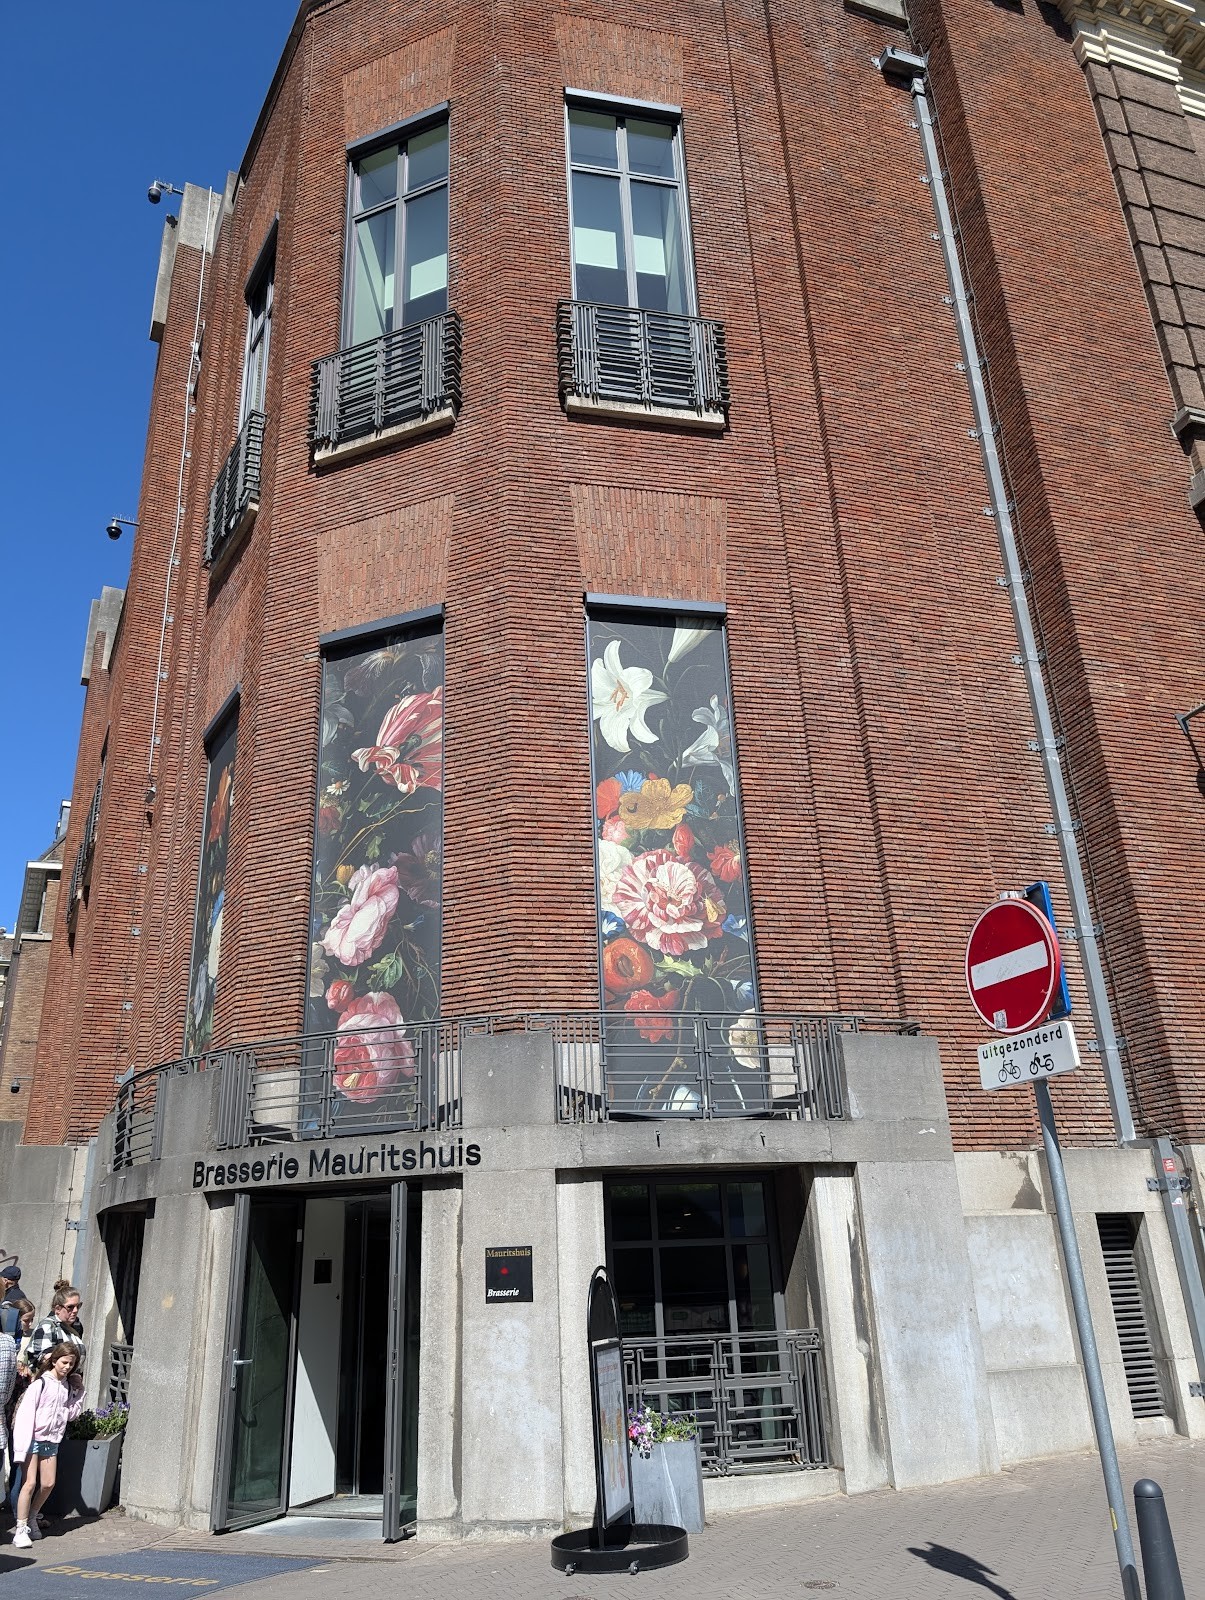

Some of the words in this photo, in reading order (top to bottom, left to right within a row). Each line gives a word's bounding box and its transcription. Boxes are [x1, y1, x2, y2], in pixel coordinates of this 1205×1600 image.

[982, 1026, 1063, 1059] uitgezonderd
[192, 1152, 299, 1188] Brasserie
[308, 1138, 481, 1177] Mauritshuis
[486, 1248, 531, 1258] Mauritshuis
[487, 1287, 519, 1297] Brasserie
[41, 1565, 220, 1586] Brasserie
